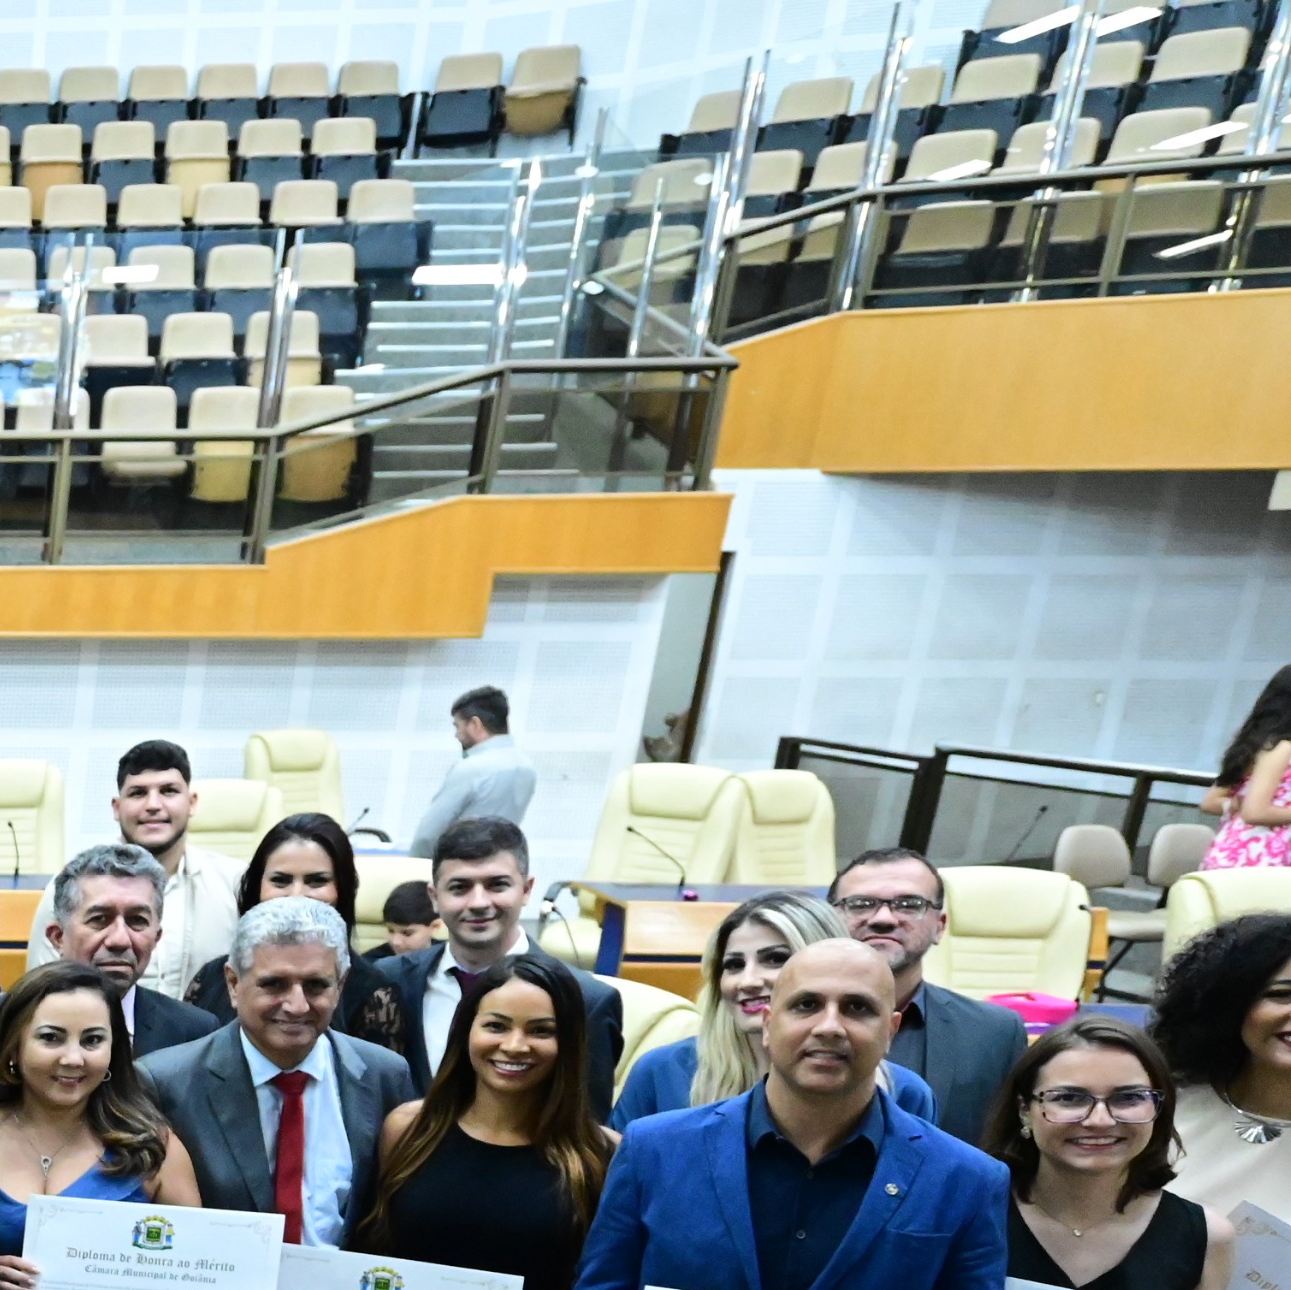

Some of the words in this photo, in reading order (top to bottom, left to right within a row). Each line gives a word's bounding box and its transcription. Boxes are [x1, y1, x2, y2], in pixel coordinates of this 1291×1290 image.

[67, 1247, 115, 1261] Diploma
[120, 1253, 131, 1263] de
[137, 1253, 173, 1266] Honra
[177, 1260, 190, 1268] ao
[194, 1259, 235, 1271] Mérito
